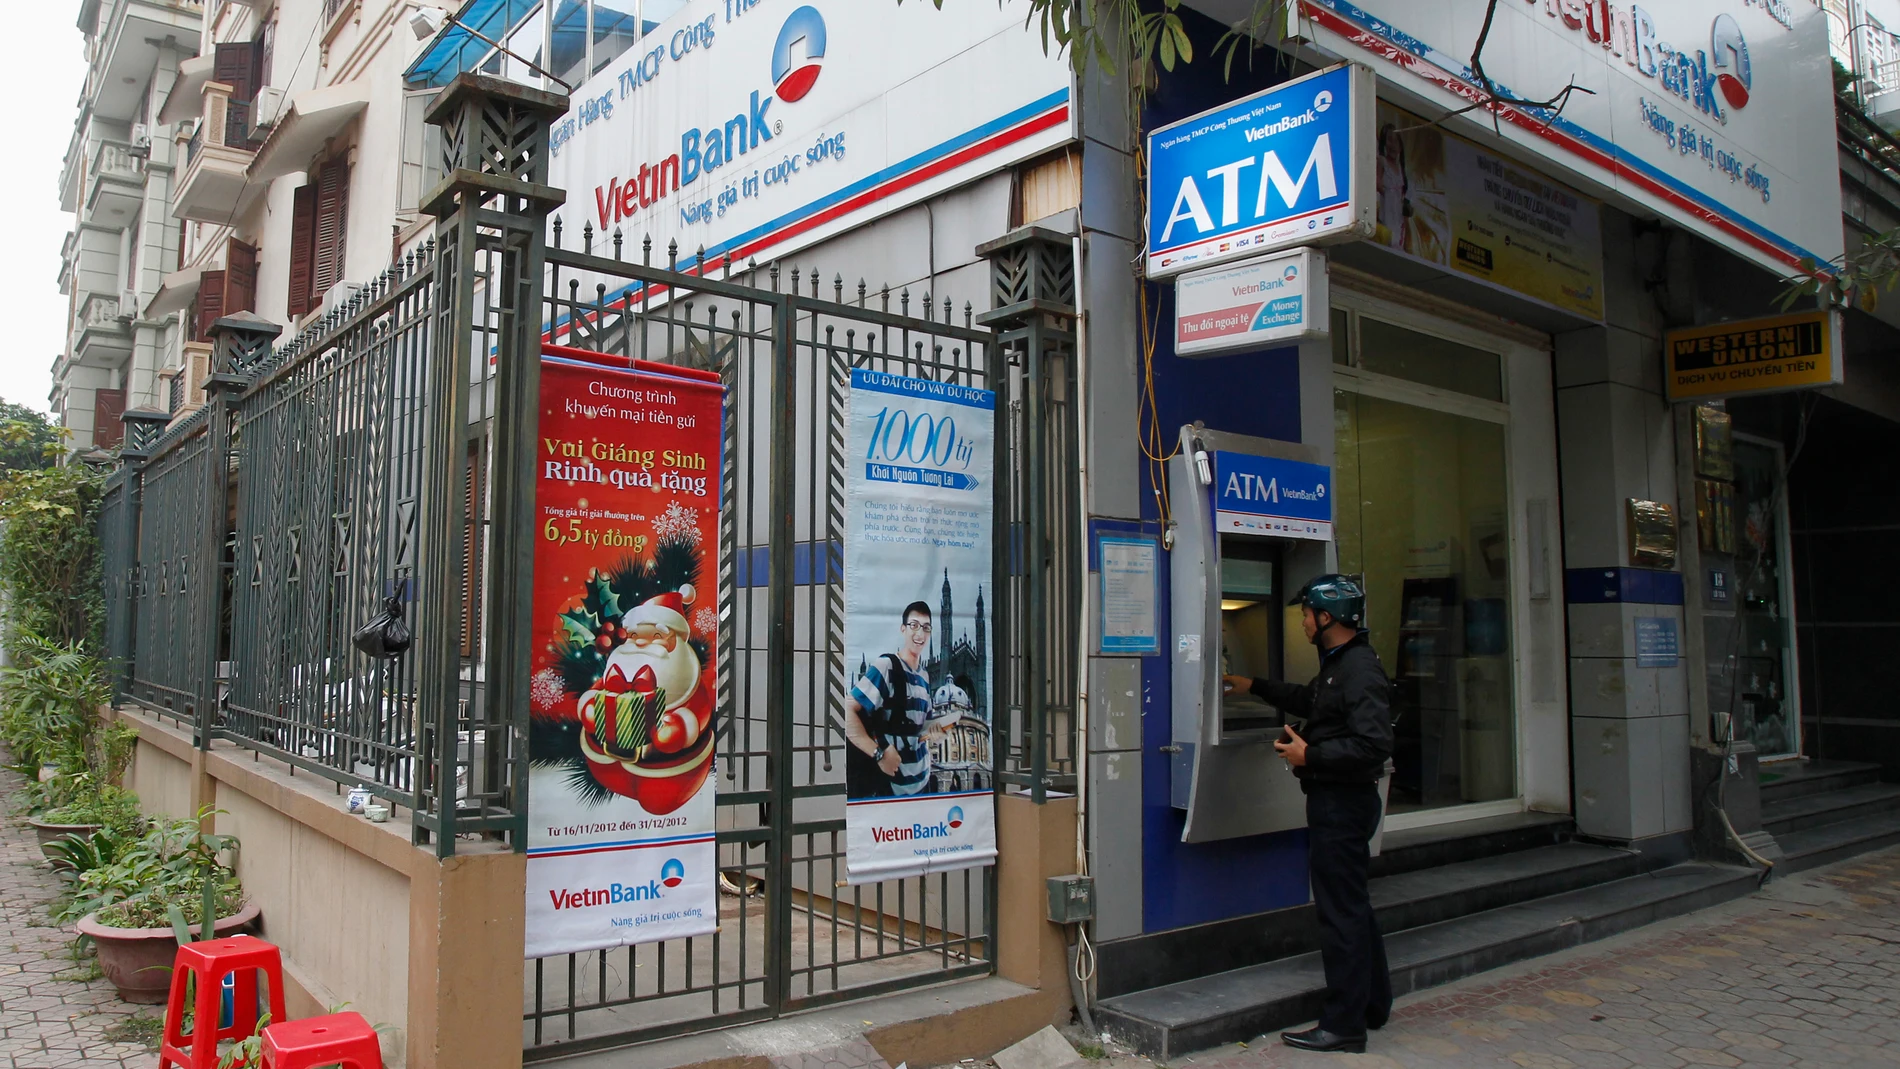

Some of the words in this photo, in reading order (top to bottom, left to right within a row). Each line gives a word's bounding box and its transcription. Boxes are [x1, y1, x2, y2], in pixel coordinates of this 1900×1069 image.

[577, 88, 615, 131] Hàng
[618, 44, 665, 100] TMCP
[670, 12, 716, 62] Công
[1192, 126, 1210, 139] TMCP
[1265, 101, 1282, 113] Nam
[1245, 108, 1315, 143] VietinBank
[595, 89, 773, 231] VietinBank
[680, 197, 713, 228] Nâng
[717, 180, 738, 218] giá
[742, 169, 759, 198] trị
[763, 154, 800, 184] cuộc
[806, 131, 846, 167] sống
[1160, 132, 1338, 244] ATM
[1232, 277, 1284, 297] VietinBank
[1262, 310, 1300, 325] Exchange
[1272, 300, 1299, 312] Money
[1183, 321, 1198, 334] Thu
[1215, 313, 1238, 331] ngoại
[1240, 313, 1249, 326] tệ
[1676, 325, 1795, 356] WESTERN
[1713, 341, 1795, 365] UNION
[589, 381, 643, 404] Chương
[646, 389, 676, 405] trình
[902, 381, 926, 392] CHO
[928, 384, 945, 395] VAY
[948, 386, 963, 398] DU
[964, 389, 986, 403] HỌC
[565, 398, 616, 419] khuyến
[620, 409, 645, 424] mại
[649, 410, 673, 425] tiền
[676, 415, 696, 430] gửi
[866, 406, 956, 467] 1.000
[544, 437, 584, 459] Vui
[591, 442, 655, 469] Giáng
[661, 449, 706, 471] Sinh
[544, 460, 603, 484] Rinh
[609, 467, 652, 490] quà
[661, 470, 707, 497] tặng
[944, 472, 954, 486] Lai
[1224, 471, 1278, 503] ATM
[1282, 487, 1318, 501] VietinBank
[544, 506, 564, 517] Tổng
[566, 507, 577, 518] giá
[579, 508, 588, 518] trị
[631, 512, 645, 521] trên
[864, 500, 887, 511] Chúng
[864, 522, 879, 532] phía
[886, 514, 899, 522] phá
[544, 517, 582, 547] 6,5
[584, 528, 599, 550] tỷ
[602, 528, 644, 553] đồng
[547, 826, 560, 837] Từ
[564, 822, 616, 837] 16/11/2012
[619, 819, 636, 831] đến
[638, 816, 687, 830] 31/12/2012
[872, 821, 948, 843] VietinBank
[929, 846, 939, 857] giá
[549, 880, 661, 910] VietinBank
[635, 912, 648, 926] giá
[650, 912, 660, 924] trị
[662, 910, 681, 921] cuộc
[683, 907, 702, 918] sống
